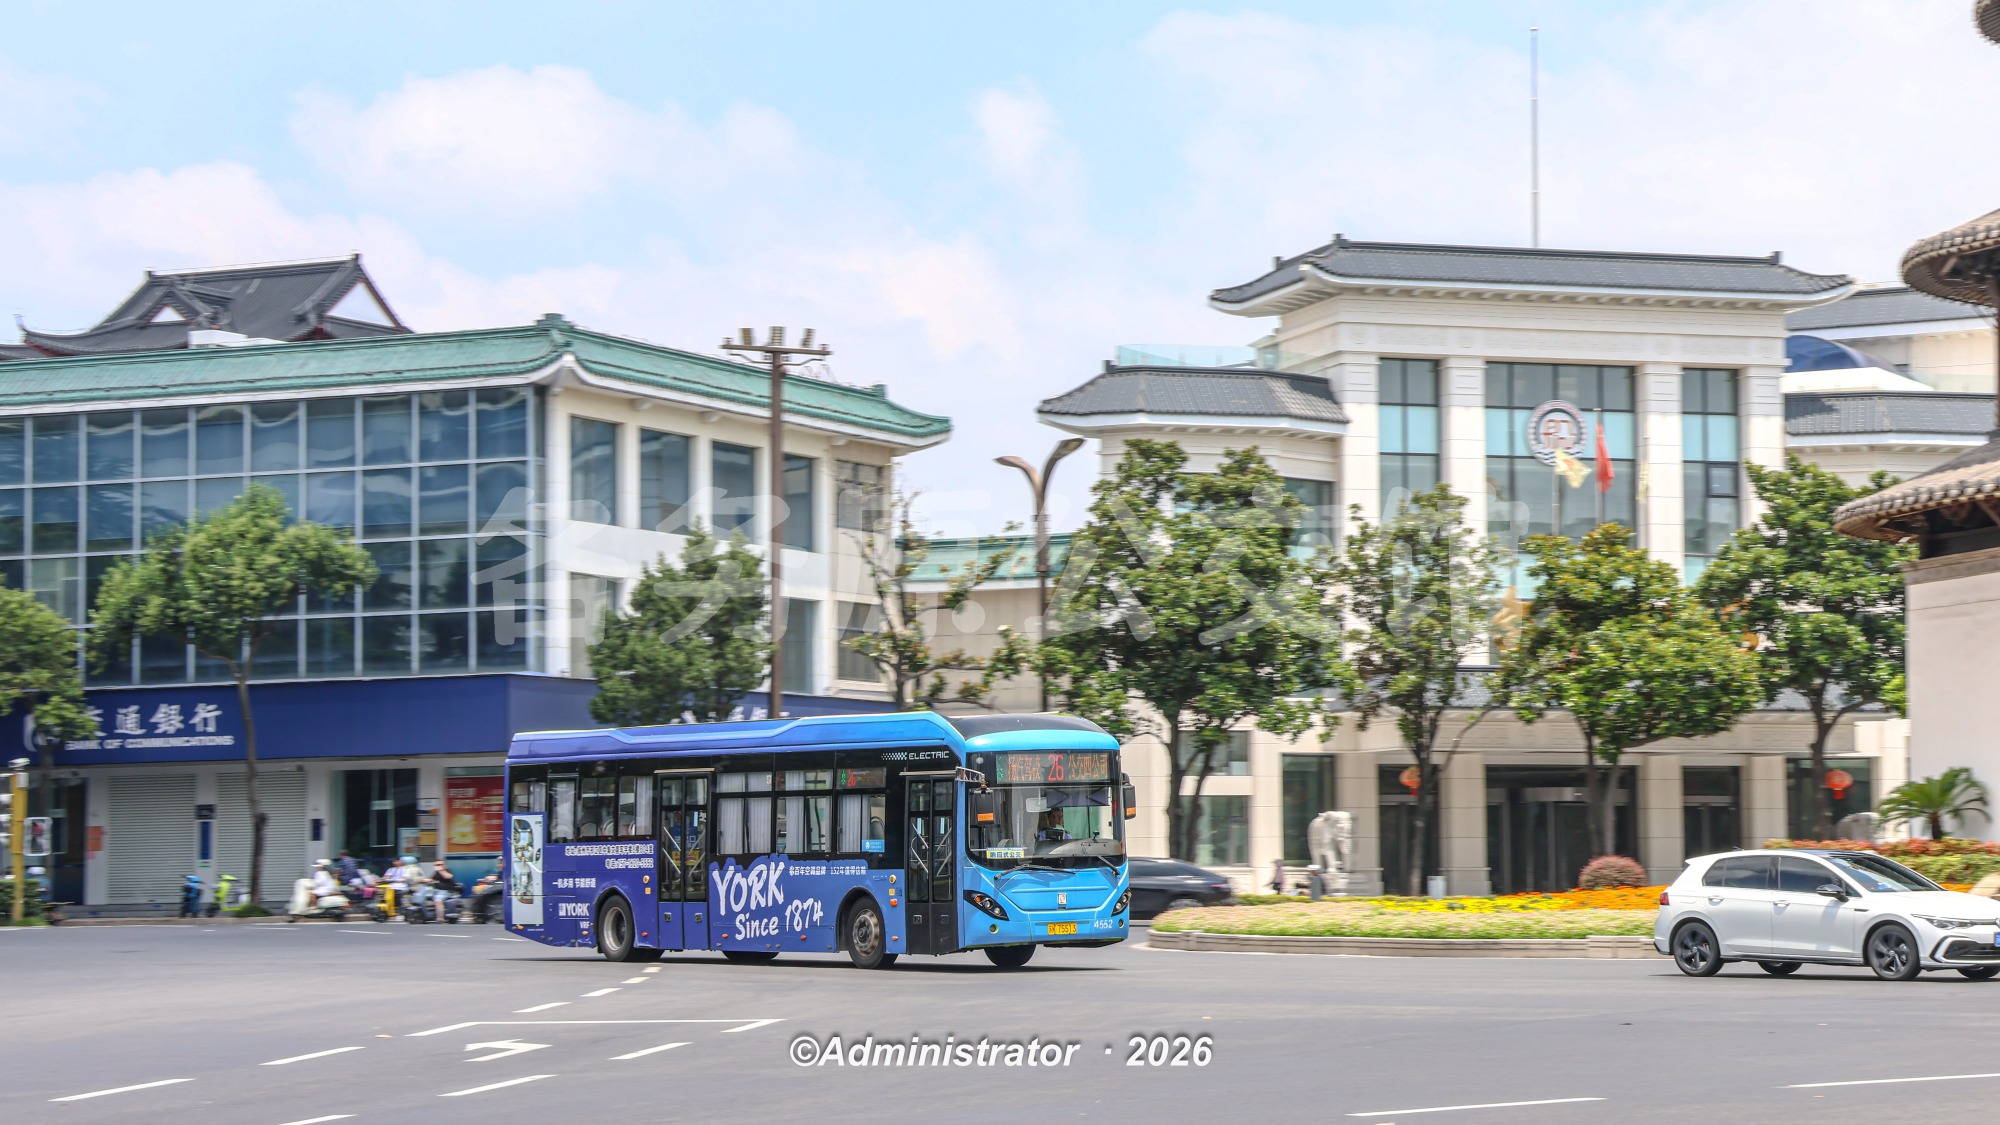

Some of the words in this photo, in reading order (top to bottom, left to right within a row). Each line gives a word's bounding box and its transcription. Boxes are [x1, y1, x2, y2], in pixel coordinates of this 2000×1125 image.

[103, 739, 123, 749] OF
[124, 736, 235, 748] COMMUNICATIONS
[908, 751, 950, 760] ELECTRIC
[1047, 753, 1064, 781] 26
[1068, 754, 1108, 780] 公交四公司
[712, 862, 785, 916] YORK
[566, 902, 590, 916] YORK
[785, 898, 823, 932] 1874
[735, 912, 779, 940] Since
